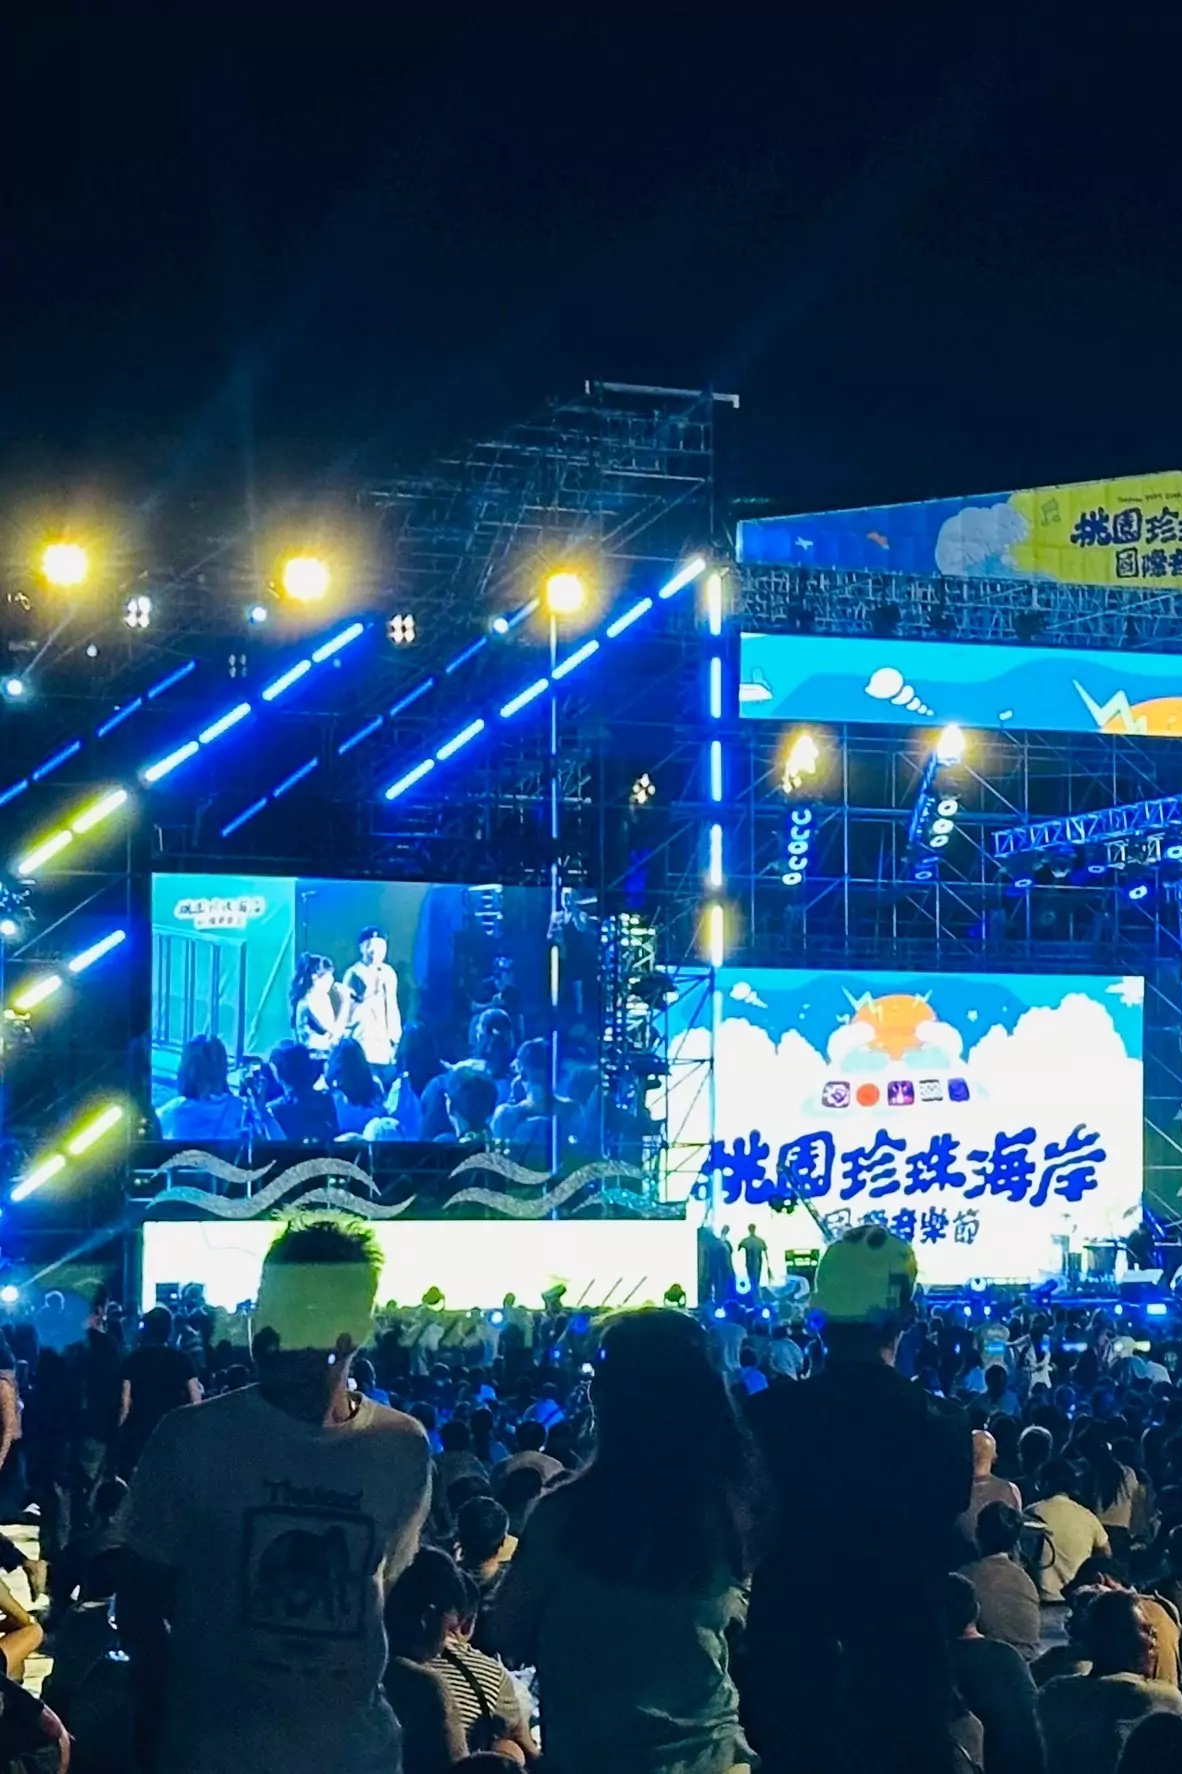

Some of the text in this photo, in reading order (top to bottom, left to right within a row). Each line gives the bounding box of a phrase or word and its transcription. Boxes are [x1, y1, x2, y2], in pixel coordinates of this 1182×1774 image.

[690, 1124, 1106, 1206] 桃園珍珠海岸
